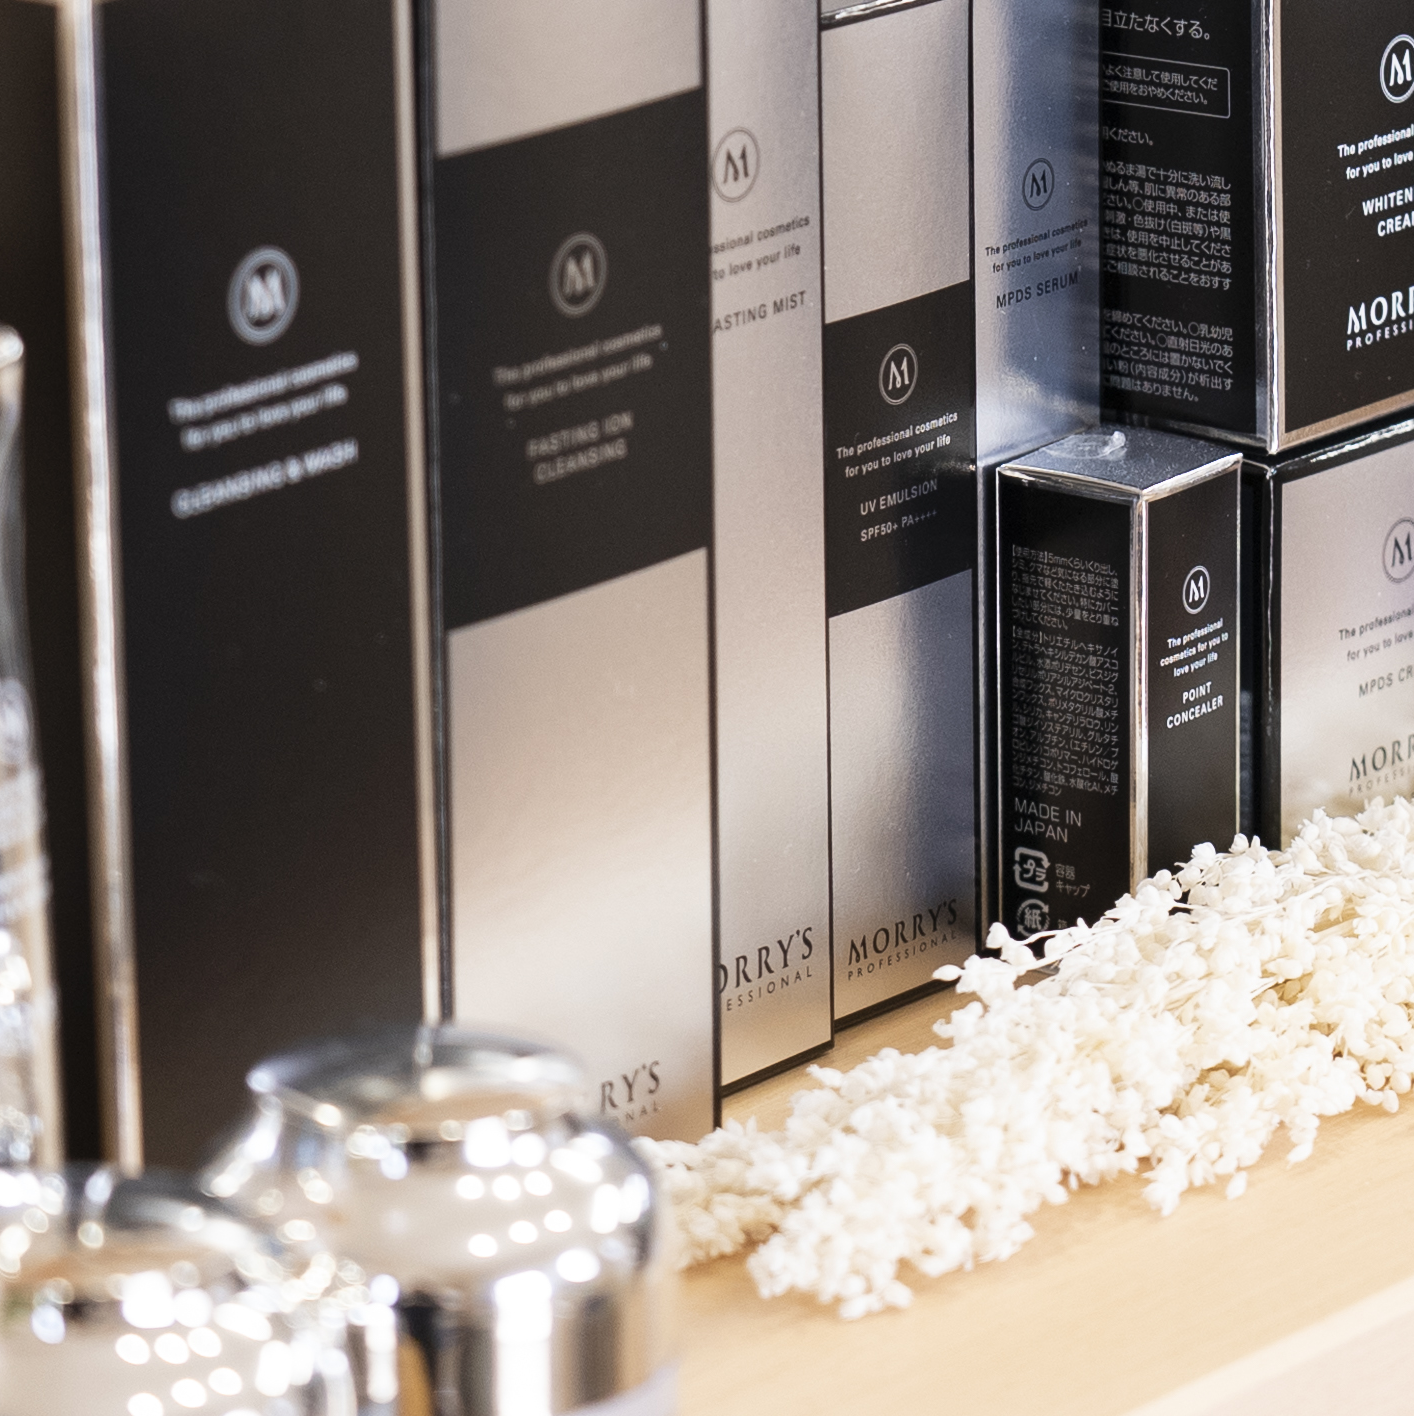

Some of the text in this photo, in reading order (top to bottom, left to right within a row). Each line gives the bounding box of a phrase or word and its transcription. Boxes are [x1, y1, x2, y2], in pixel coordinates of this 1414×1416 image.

[1102, 65, 1218, 91] よく注意して使用してくだ
[1337, 144, 1355, 157] The
[1358, 124, 1414, 155] professional
[1346, 167, 1360, 179] for
[1362, 161, 1380, 177] you
[1382, 158, 1392, 169] to
[1394, 151, 1413, 165] love
[713, 231, 753, 255] ssional
[996, 271, 1078, 309] MPDS SERUM
[713, 304, 767, 336] ASTING
[837, 413, 957, 459] The professional cosmetics
[537, 439, 627, 481] CLEANSING
[845, 434, 950, 477] for you to love your life
[861, 480, 936, 515] UV EMULSION
[861, 511, 936, 541] SPF50+ PA++++
[1167, 618, 1223, 648] The professional
[1160, 633, 1228, 666] cosmetics for you to
[1174, 652, 1217, 677] love your life
[1183, 682, 1211, 704] POINT
[1359, 673, 1393, 696] MPDS
[1167, 695, 1223, 728] CONCEALER
[1014, 797, 1082, 827] MADE IN
[1014, 818, 1068, 843] JAPAN
[1023, 859, 1047, 881] プラ
[1055, 863, 1076, 880] 容器
[848, 898, 957, 966] MORRY'S
[720, 926, 813, 994] ORRY'S
[848, 930, 957, 982] PROFESSIONAL
[727, 965, 812, 1012] ESSIONAL
[600, 1061, 660, 1116] RY'S
